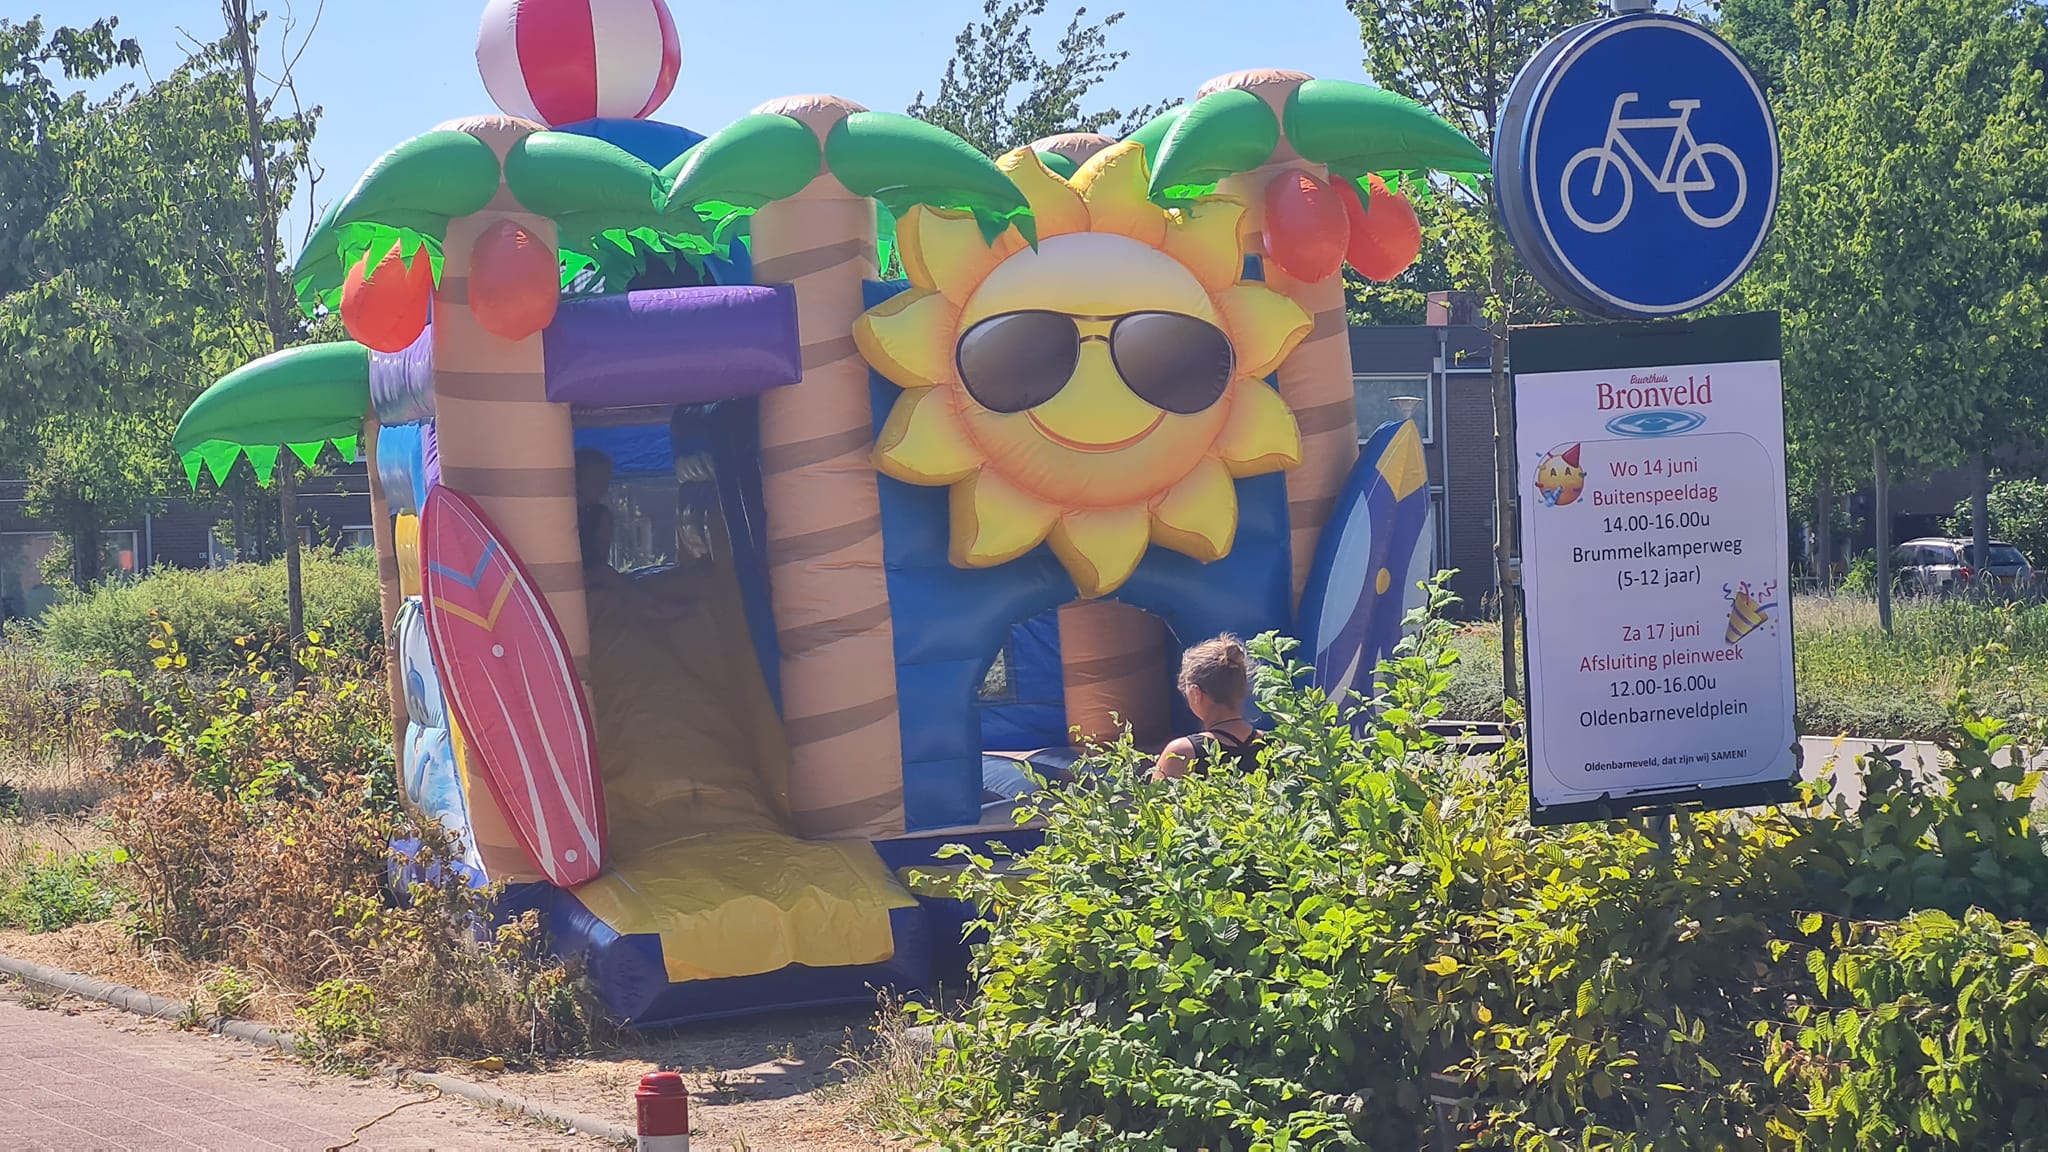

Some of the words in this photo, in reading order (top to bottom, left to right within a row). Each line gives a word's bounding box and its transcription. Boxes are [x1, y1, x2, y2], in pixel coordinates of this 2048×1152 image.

[1630, 374, 1668, 385] Buurthuis
[1596, 375, 1712, 410] Bronveld
[1609, 462, 1638, 477] Wo
[1644, 459, 1663, 475] 14
[1667, 457, 1698, 478] juni
[1593, 484, 1718, 506] Buitenspeeldag
[1603, 511, 1711, 533] 14.00-16.00u
[1573, 538, 1742, 562] Brummelkamperweg
[1617, 569, 1660, 590] (5-12
[1664, 566, 1701, 588] jaar)
[1622, 625, 1641, 641] Za
[1647, 623, 1665, 639] 17
[1670, 621, 1700, 641] juni
[1579, 653, 1658, 672] Afsluiting
[1662, 645, 1744, 669] pleinweek
[1610, 675, 1717, 697] 12.00-16.00u
[1580, 700, 1749, 727] Oldenbarneveldplein
[1584, 758, 1660, 772] Oldenbarneveld,
[1662, 755, 1677, 765] dat
[1679, 754, 1694, 765] zijn
[1696, 752, 1709, 763] wij
[1711, 749, 1747, 761] SAMEN!
